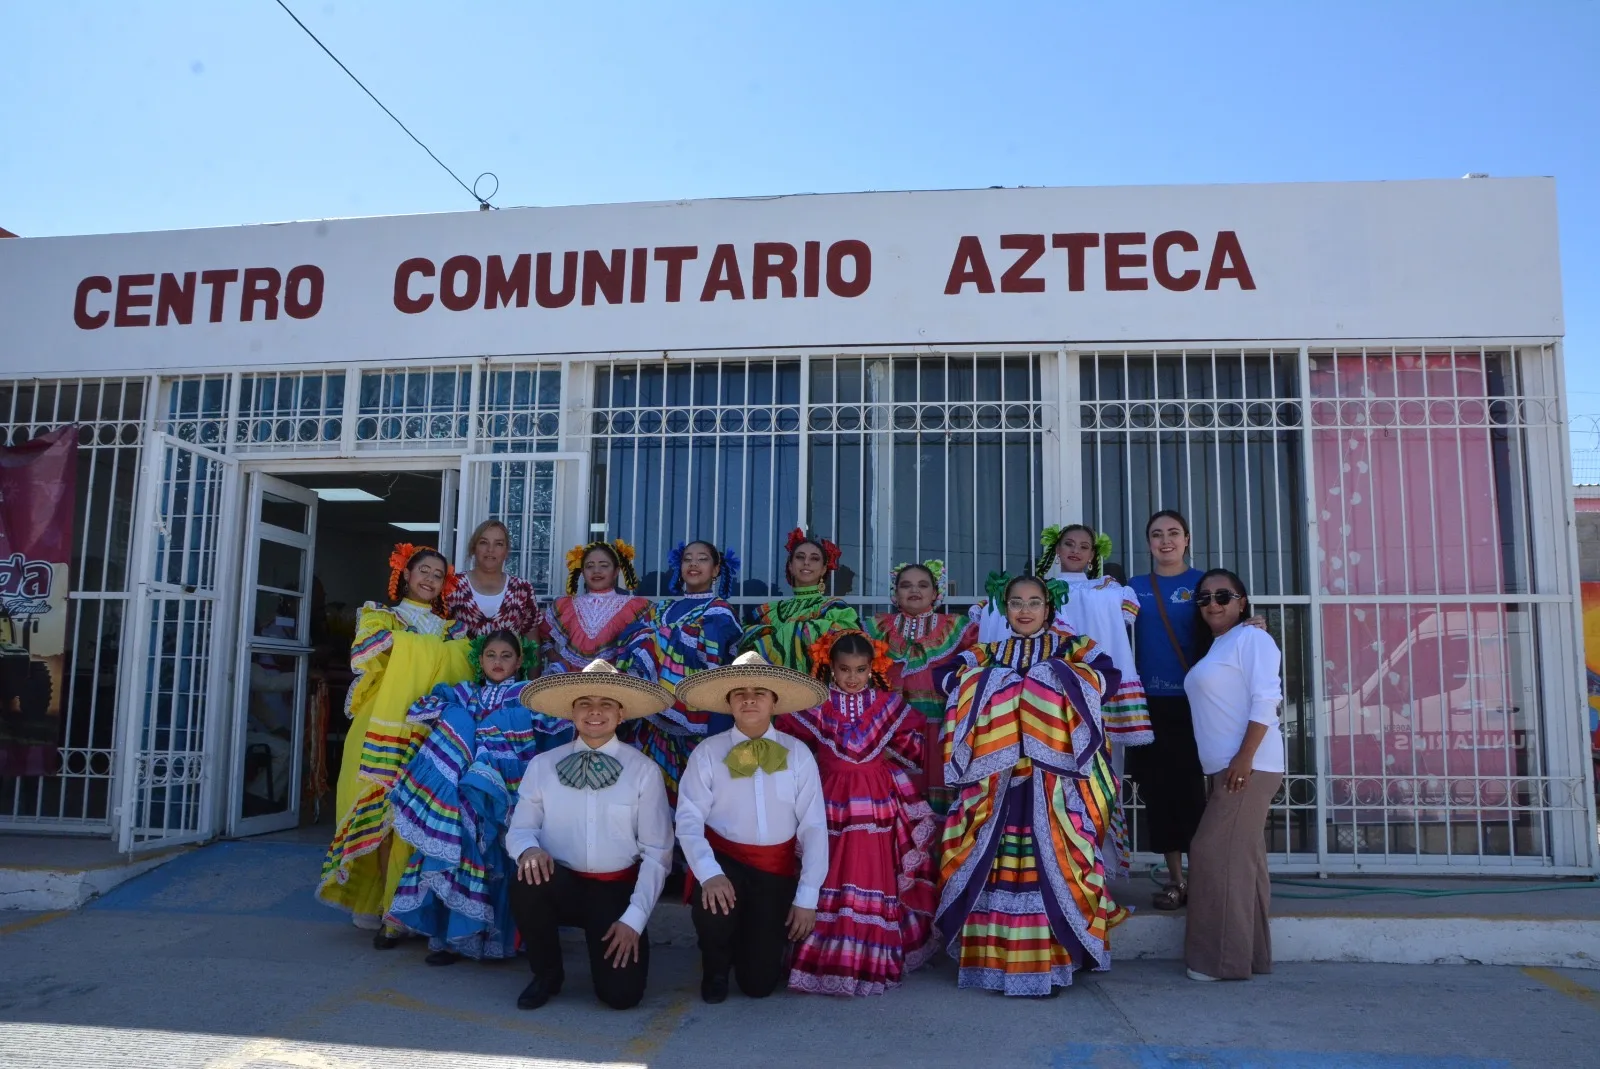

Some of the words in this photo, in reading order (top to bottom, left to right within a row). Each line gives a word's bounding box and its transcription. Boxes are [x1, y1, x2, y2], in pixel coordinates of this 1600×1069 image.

[75, 265, 325, 330] CENTRO
[393, 240, 872, 314] COMUNITARIO
[943, 231, 1257, 295] AZTECA
[5, 598, 53, 616] Familia
